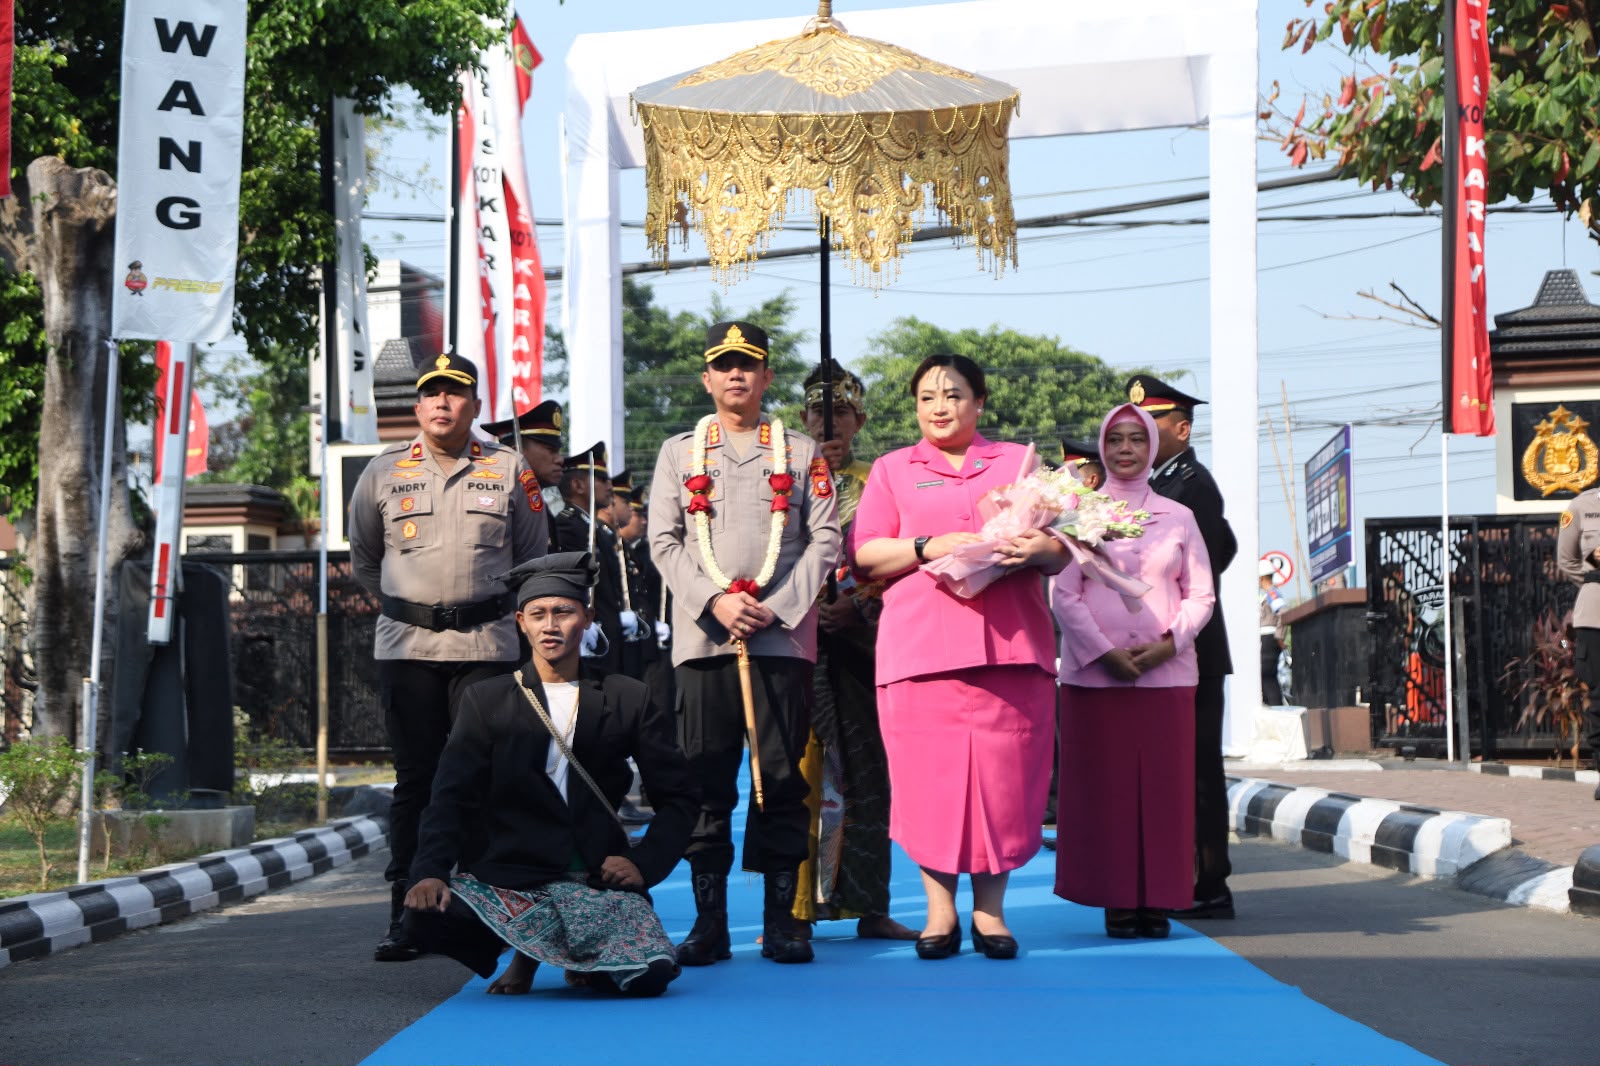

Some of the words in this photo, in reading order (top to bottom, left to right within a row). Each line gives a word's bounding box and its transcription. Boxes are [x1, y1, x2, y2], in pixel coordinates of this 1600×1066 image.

[154, 17, 218, 230] WANG
[391, 482, 427, 494] ANDRY
[467, 482, 505, 492] POLRI
